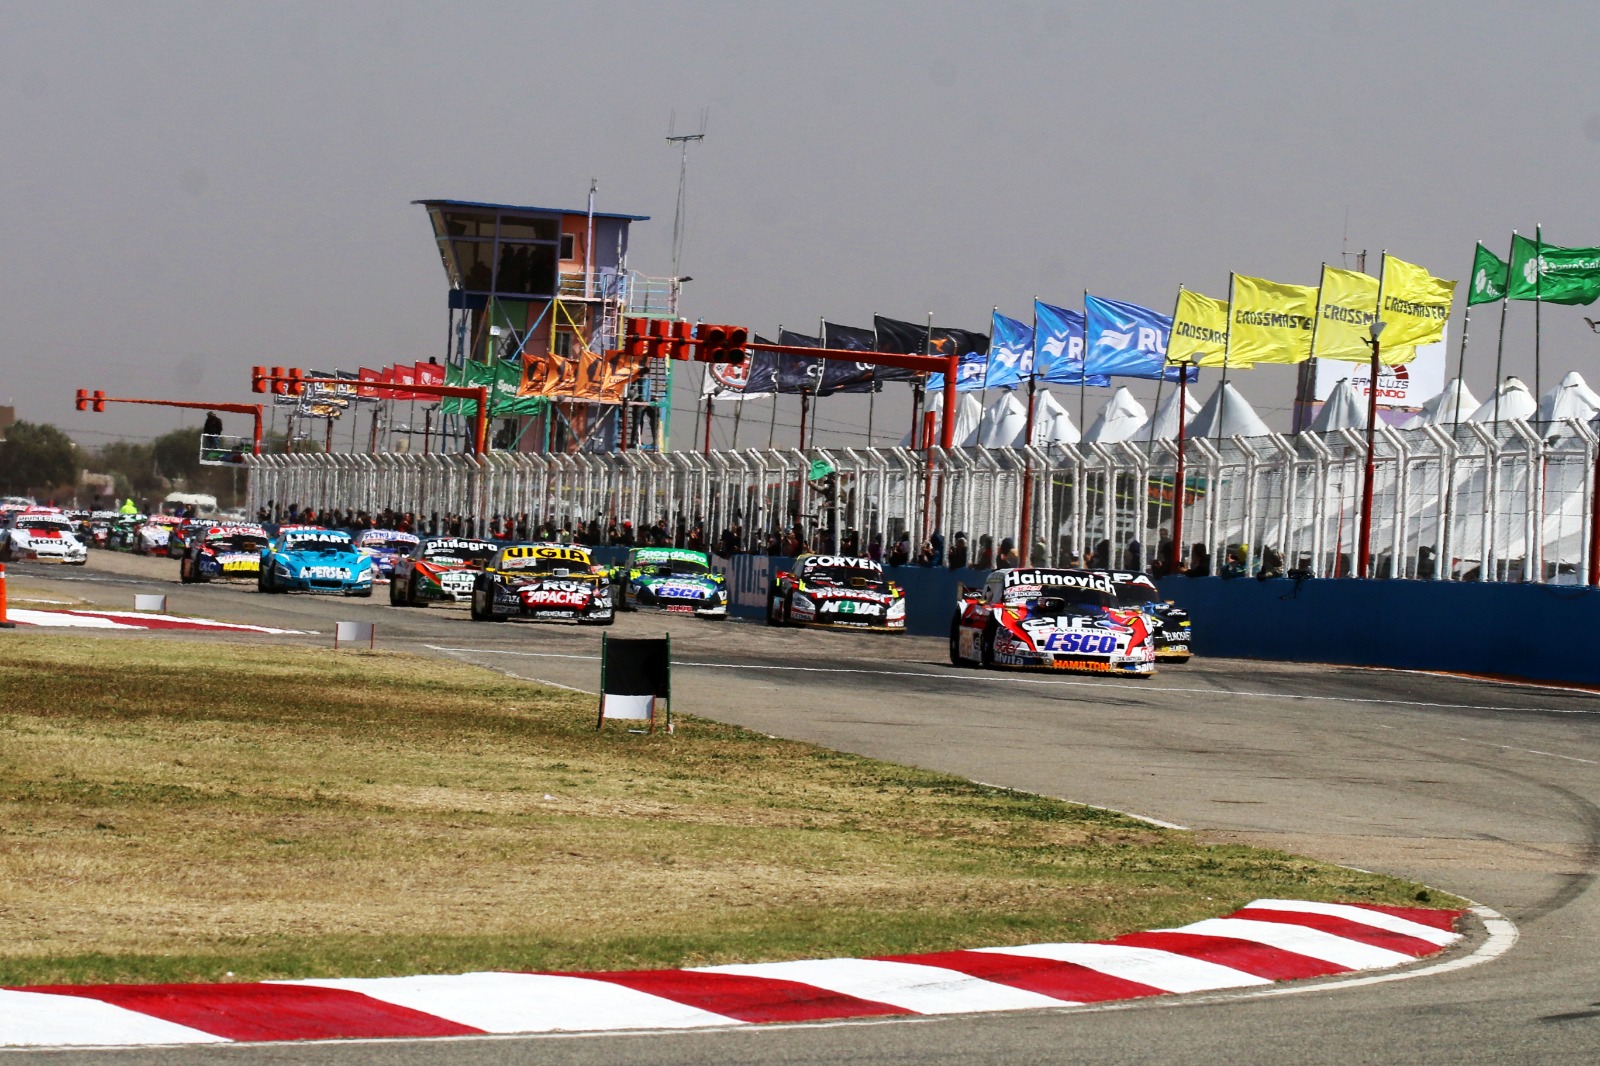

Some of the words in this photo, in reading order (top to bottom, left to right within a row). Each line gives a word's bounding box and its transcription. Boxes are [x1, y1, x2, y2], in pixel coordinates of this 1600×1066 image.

[427, 539, 497, 551] philagro
[804, 556, 883, 572] CORVEN
[1004, 570, 1117, 596] Haimovich
[528, 591, 584, 604] APACHE
[1043, 633, 1117, 653] ESCO
[1053, 660, 1111, 671] HAMILTON
